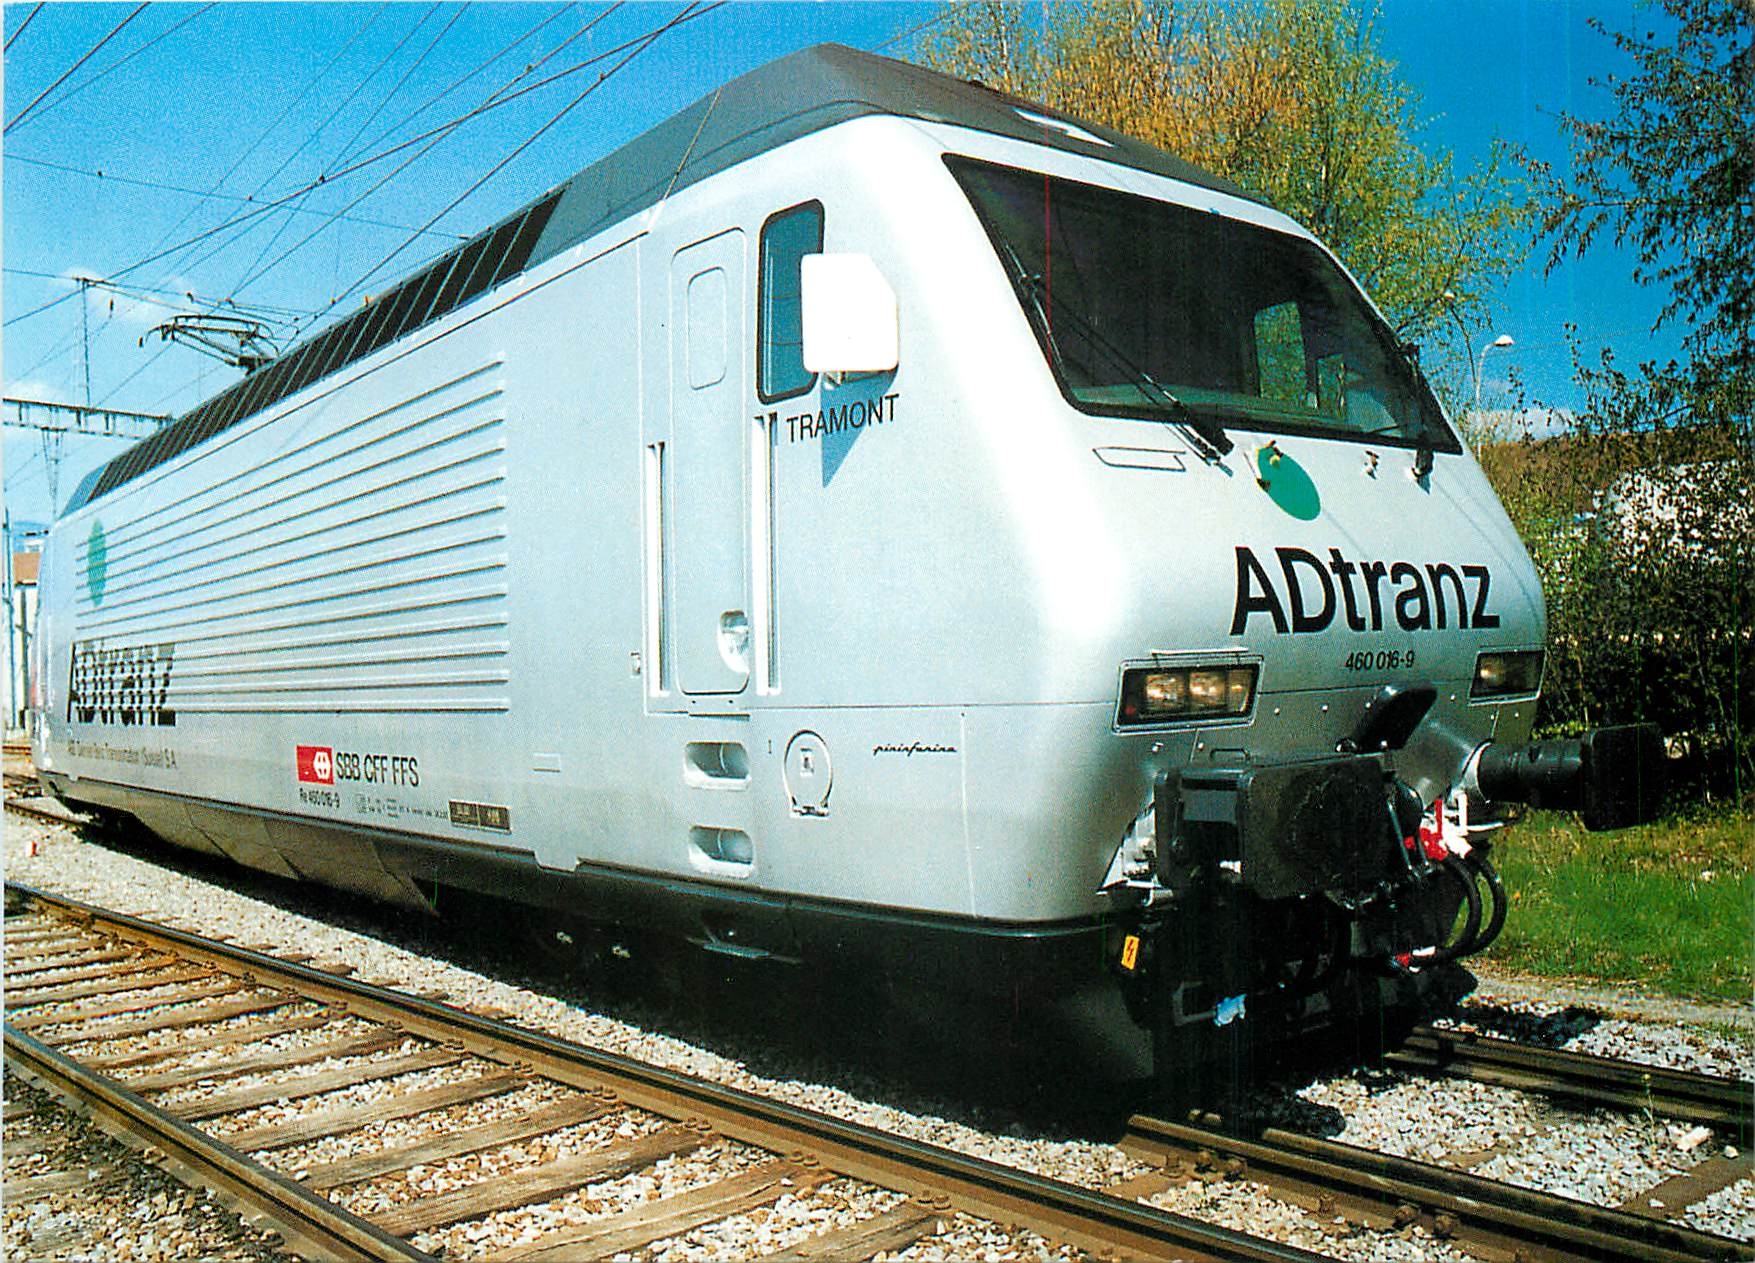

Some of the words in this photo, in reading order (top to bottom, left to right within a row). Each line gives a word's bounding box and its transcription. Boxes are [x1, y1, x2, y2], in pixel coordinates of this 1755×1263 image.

[787, 393, 900, 443] TRAMONT
[1229, 546, 1500, 636] ADtranz
[1345, 651, 1374, 671] 460
[1376, 649, 1416, 670] 016-9
[336, 752, 361, 782] SBB
[363, 754, 388, 784] CFF
[392, 756, 420, 787] FFS
